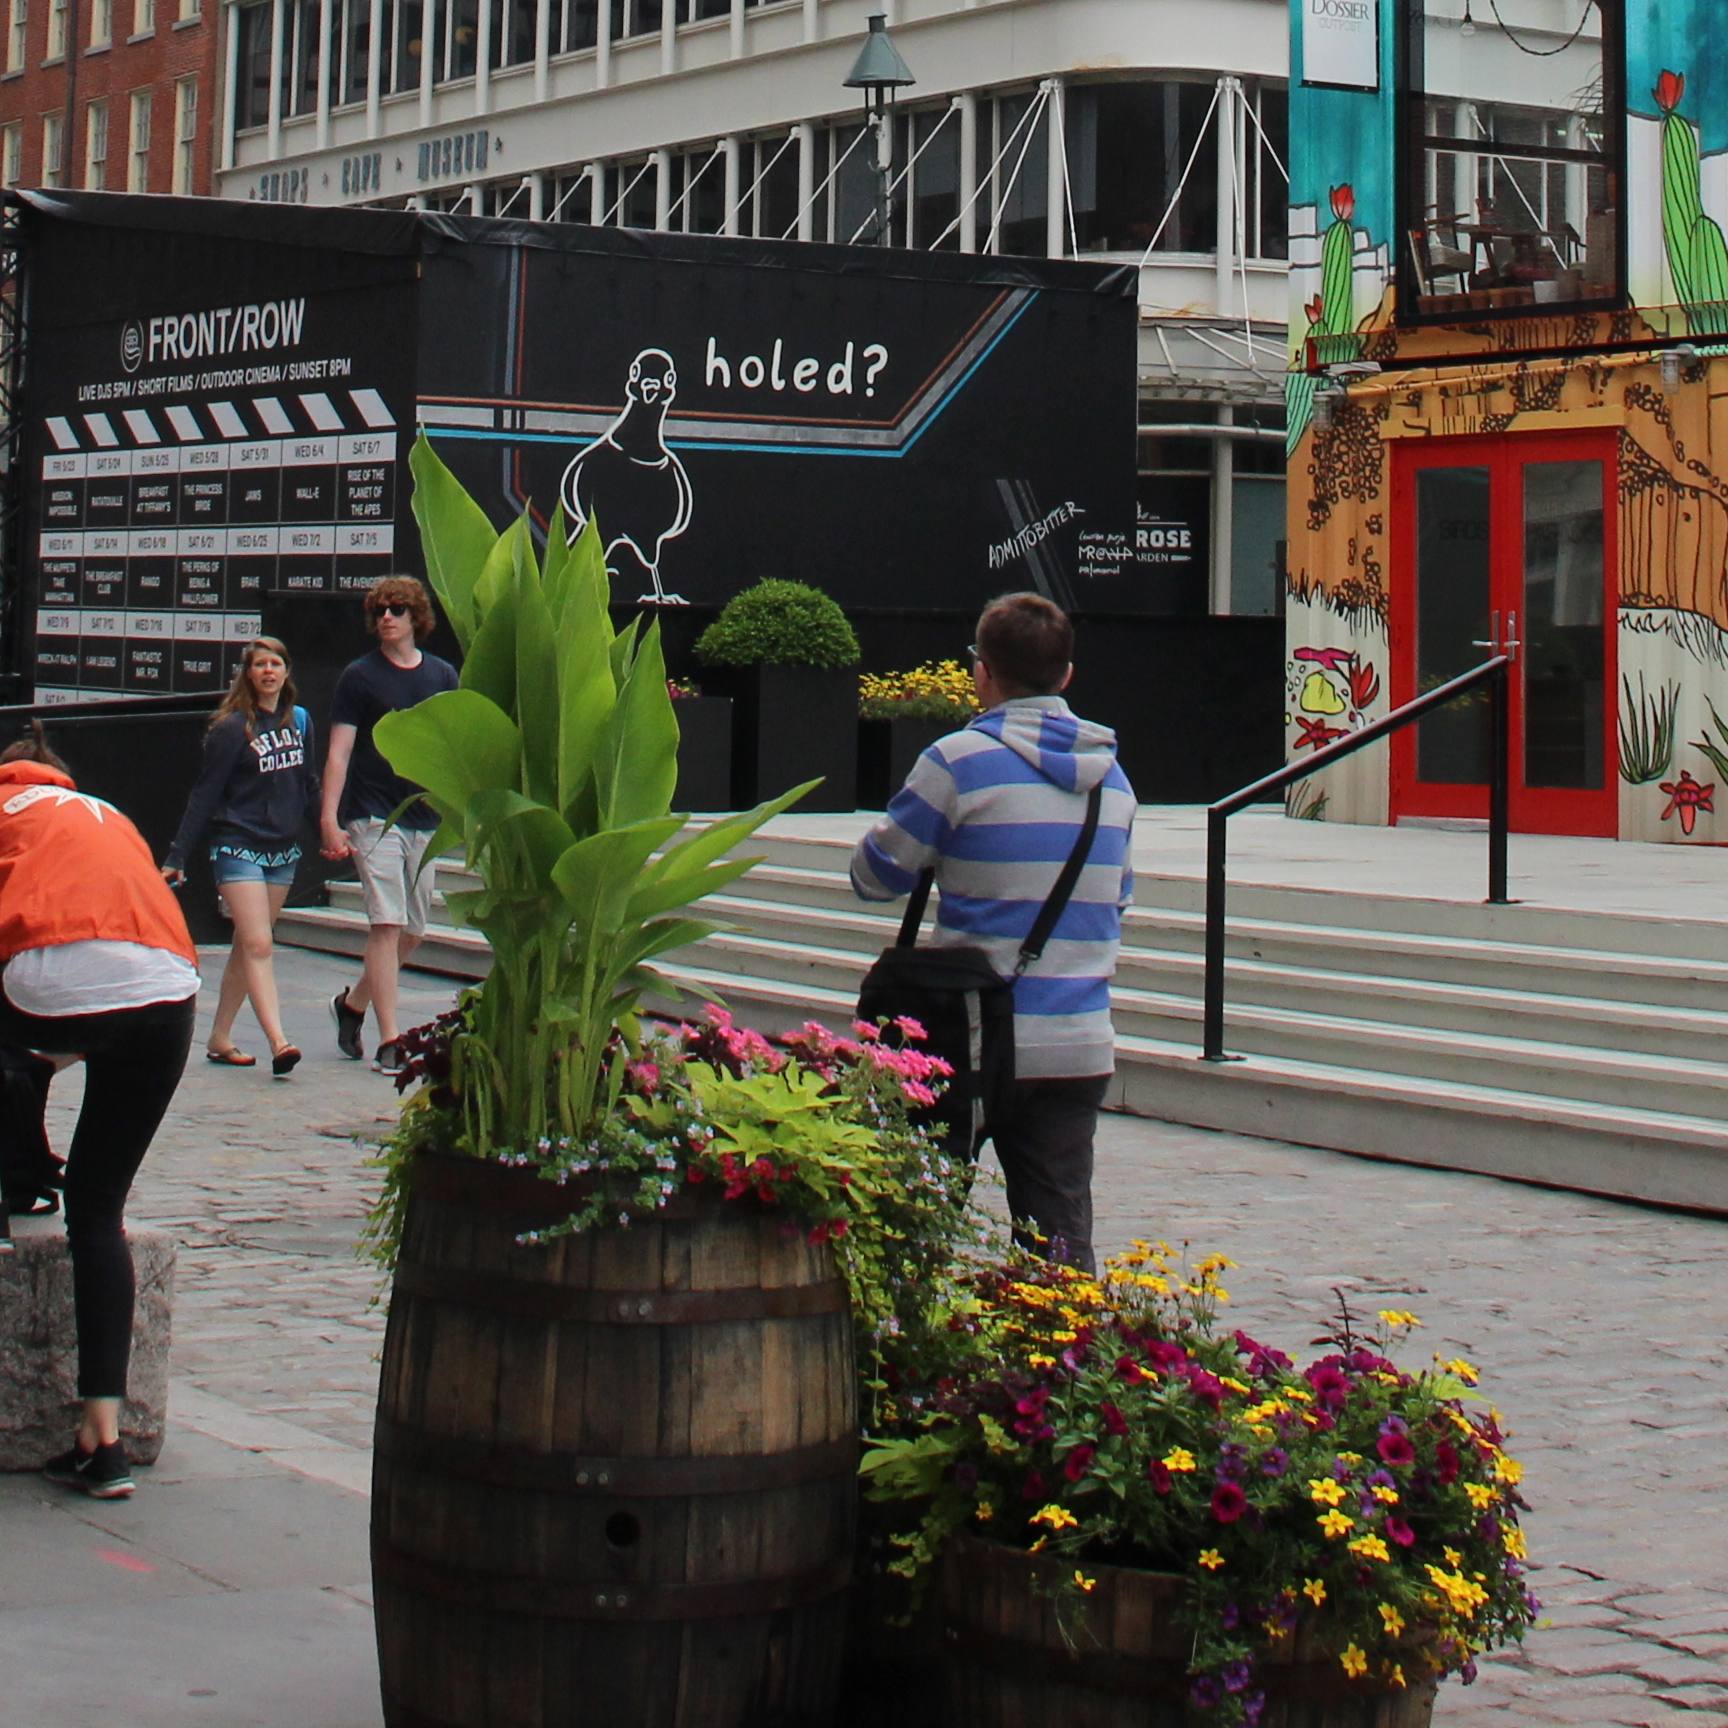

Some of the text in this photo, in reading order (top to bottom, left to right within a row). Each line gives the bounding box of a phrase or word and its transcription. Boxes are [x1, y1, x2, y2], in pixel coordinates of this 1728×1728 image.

[703, 336, 889, 398] holed?
[78, 383, 97, 401] LIVE
[97, 381, 113, 401] DJS
[113, 378, 131, 399] 5PM
[138, 375, 168, 396] SHORT
[168, 373, 194, 393] FILMS
[201, 368, 245, 390] OUTDOOR
[245, 365, 282, 386] CINEMA
[289, 360, 329, 381] SUNSET
[329, 357, 352, 377] 8PM
[353, 442, 368, 455] SAT
[350, 533, 365, 546] SAT
[1136, 530, 1192, 548] ROSE
[258, 748, 304, 773] COLLEG
